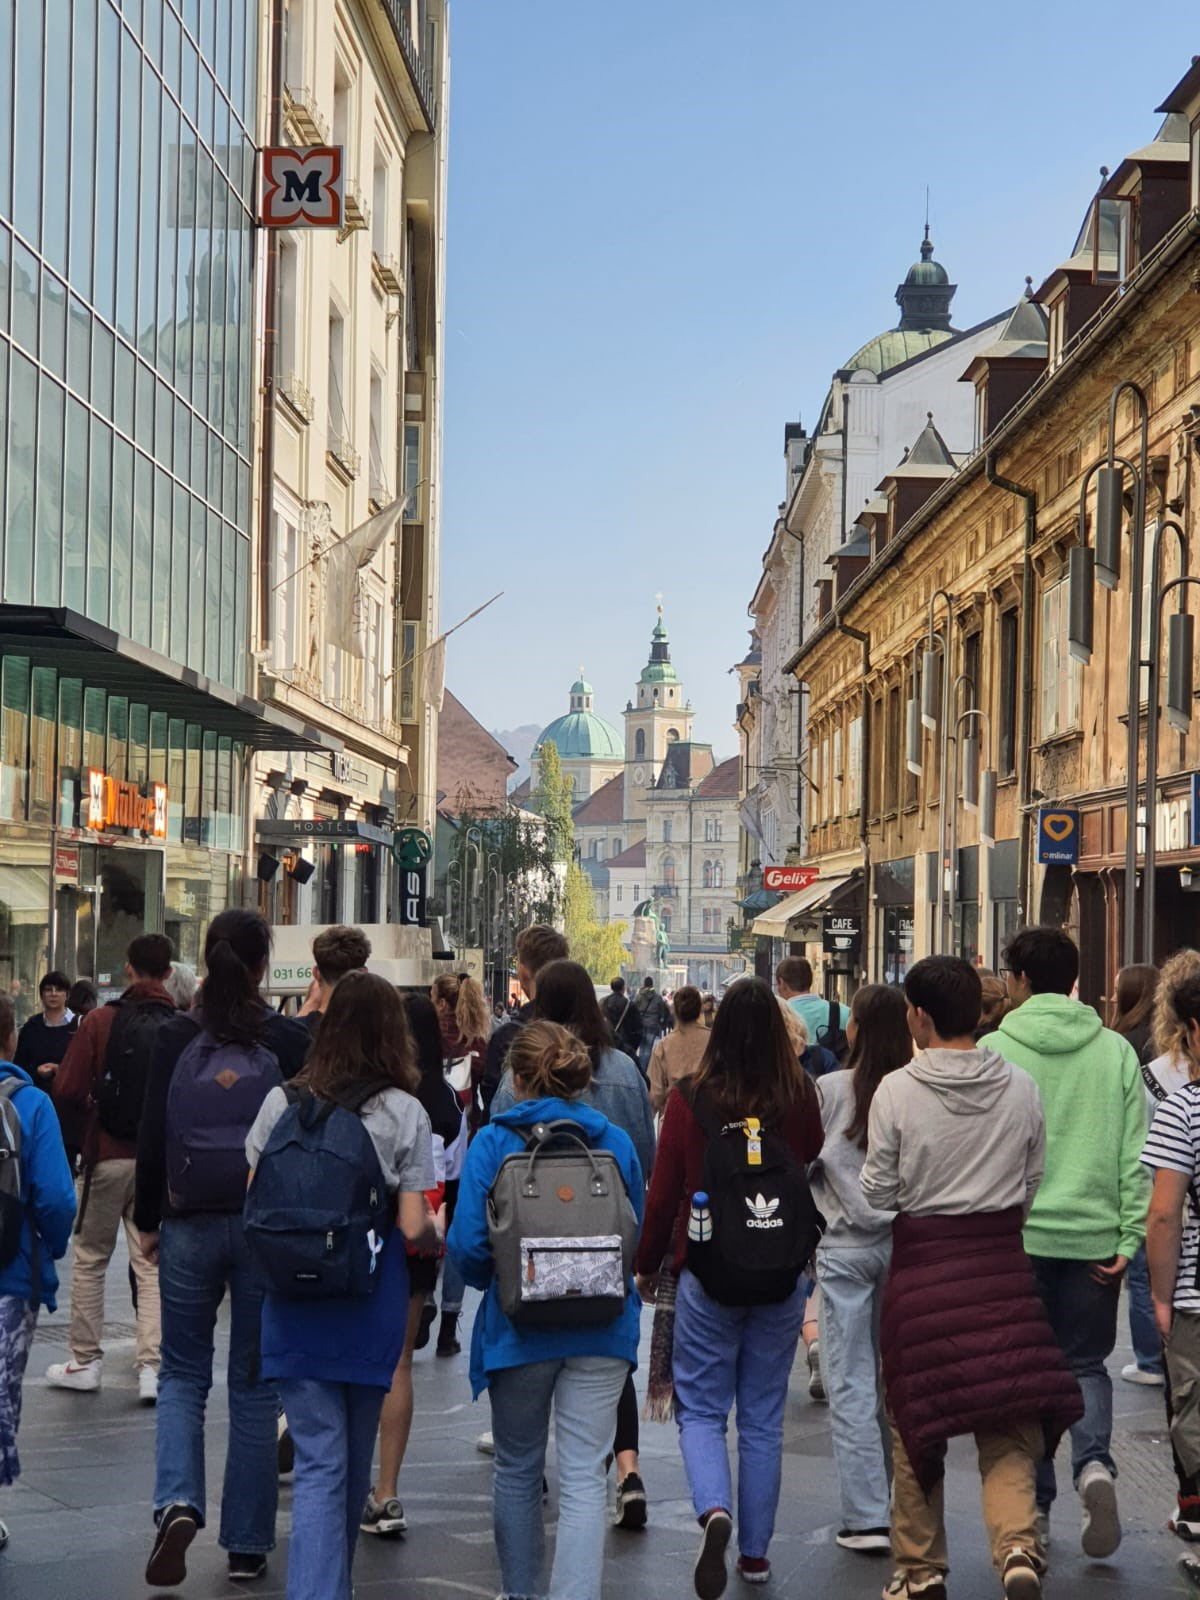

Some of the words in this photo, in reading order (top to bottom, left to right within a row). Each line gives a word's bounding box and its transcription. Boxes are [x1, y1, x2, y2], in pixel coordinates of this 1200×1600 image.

[282, 170, 323, 202] M
[103, 776, 153, 831] Müller
[293, 822, 354, 832] HOSTEL
[1049, 851, 1073, 860] mlinar
[767, 870, 808, 887] Felix
[831, 918, 853, 929] CAFE
[273, 968, 293, 980] 031
[296, 967, 312, 978] 66
[746, 1218, 784, 1229] adidas
